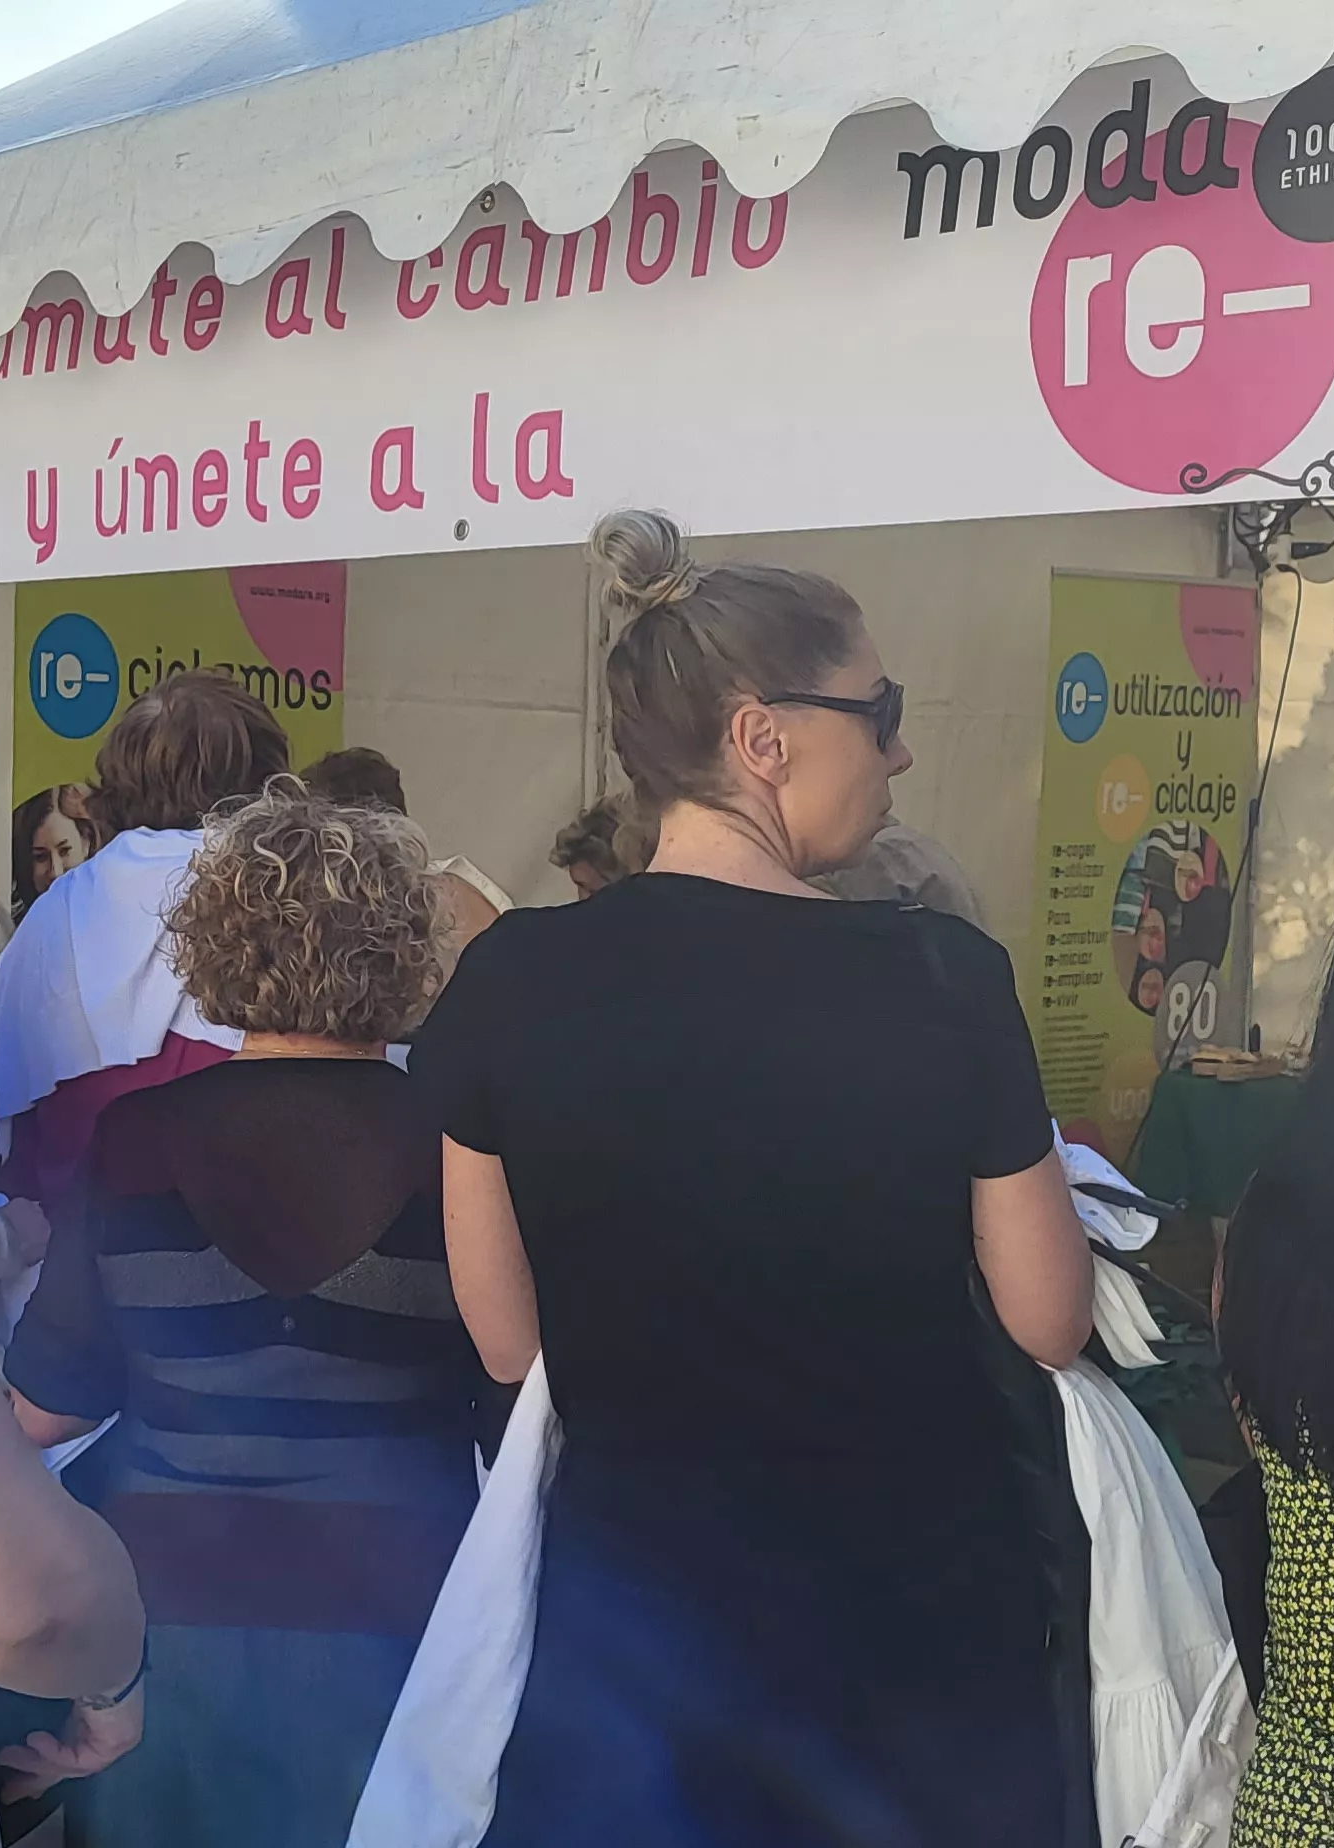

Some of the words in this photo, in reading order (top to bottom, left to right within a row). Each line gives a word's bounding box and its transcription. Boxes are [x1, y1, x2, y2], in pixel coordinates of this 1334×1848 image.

[897, 79, 1239, 240] moda
[265, 227, 347, 340] al
[397, 160, 789, 320] cambio
[1064, 245, 1310, 387] re-
[26, 467, 58, 564] y
[95, 420, 322, 538] únete
[369, 426, 425, 511] a
[472, 392, 574, 504] la
[40, 651, 110, 699] re-
[1062, 681, 1102, 715] re-
[1114, 671, 1242, 719] utilización
[1177, 730, 1192, 771] y
[1102, 781, 1143, 814] re-
[1156, 773, 1236, 822] ciclaje
[1168, 979, 1217, 1042] 80
